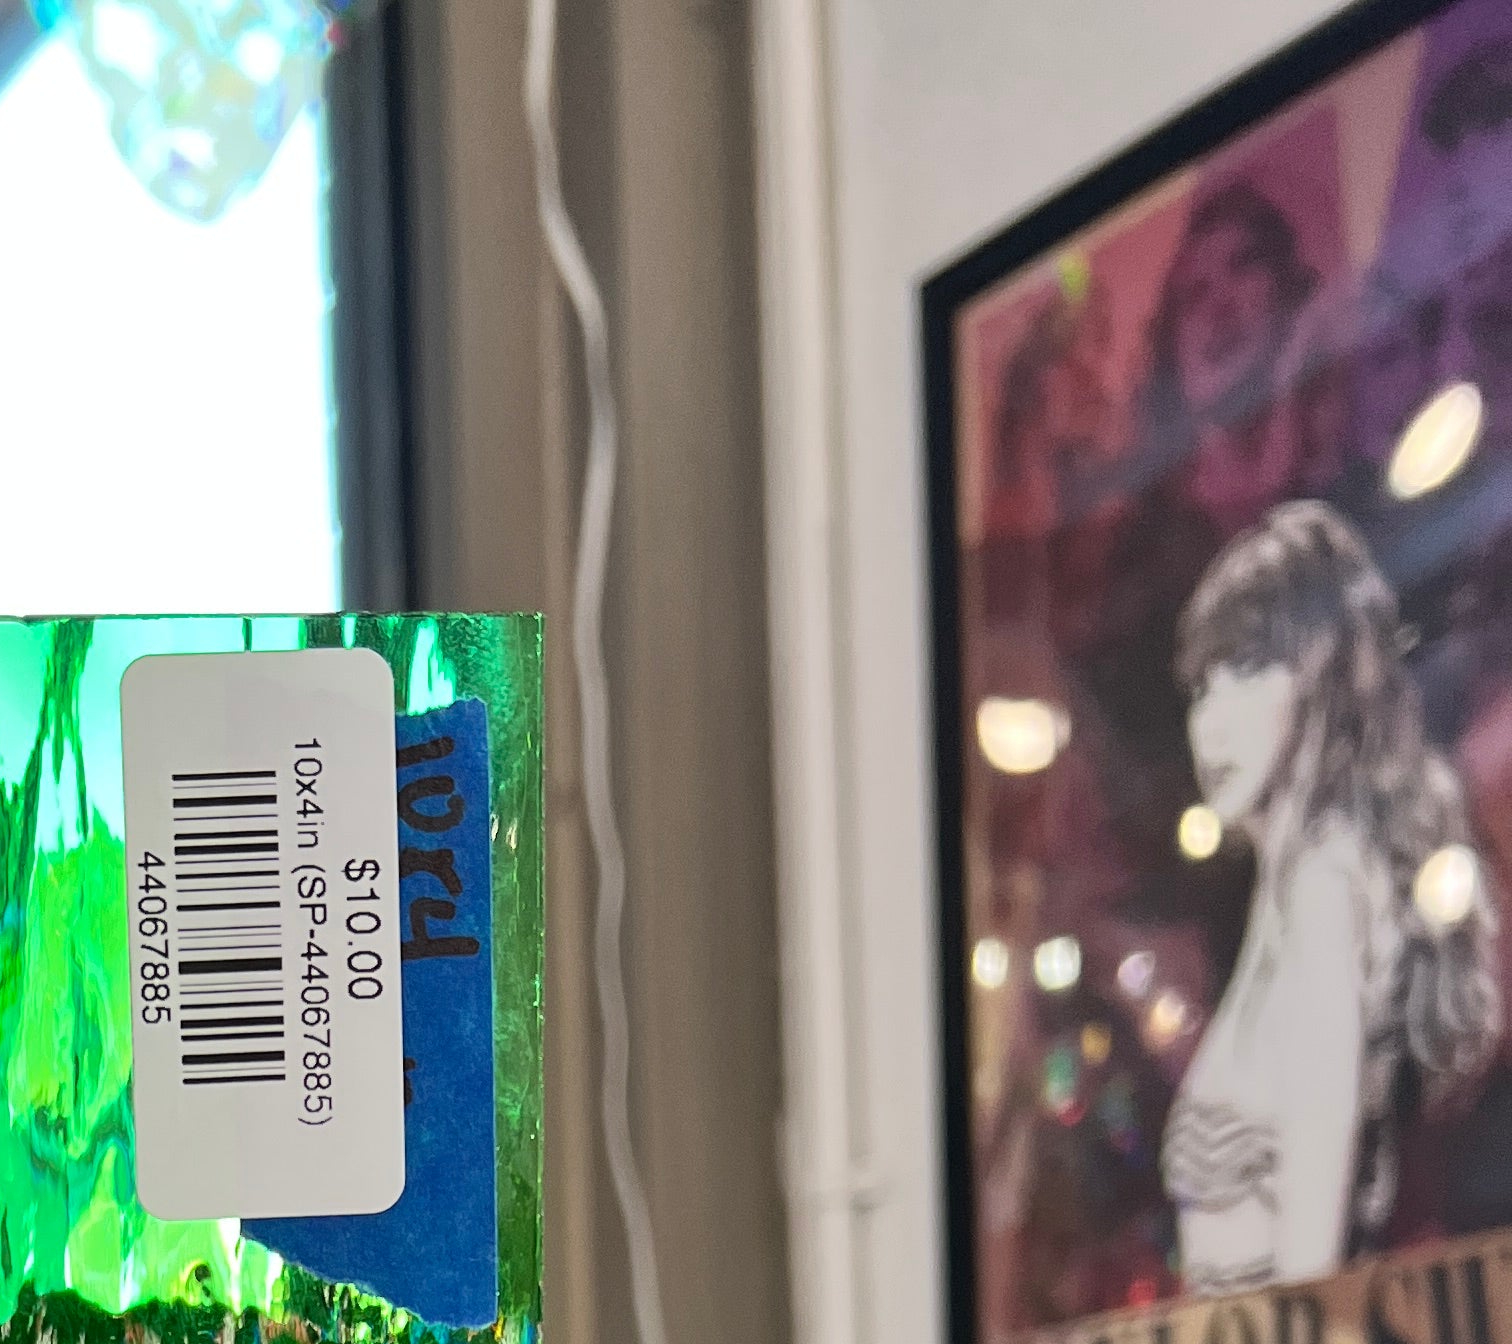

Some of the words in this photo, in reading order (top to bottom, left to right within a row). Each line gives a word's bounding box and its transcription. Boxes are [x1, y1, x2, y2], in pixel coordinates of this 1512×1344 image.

[292, 737, 325, 850] 10x4in
[136, 850, 173, 1025] 44067885
[290, 863, 334, 1127] (SP-44067885)
[340, 857, 385, 1001] $10.00
